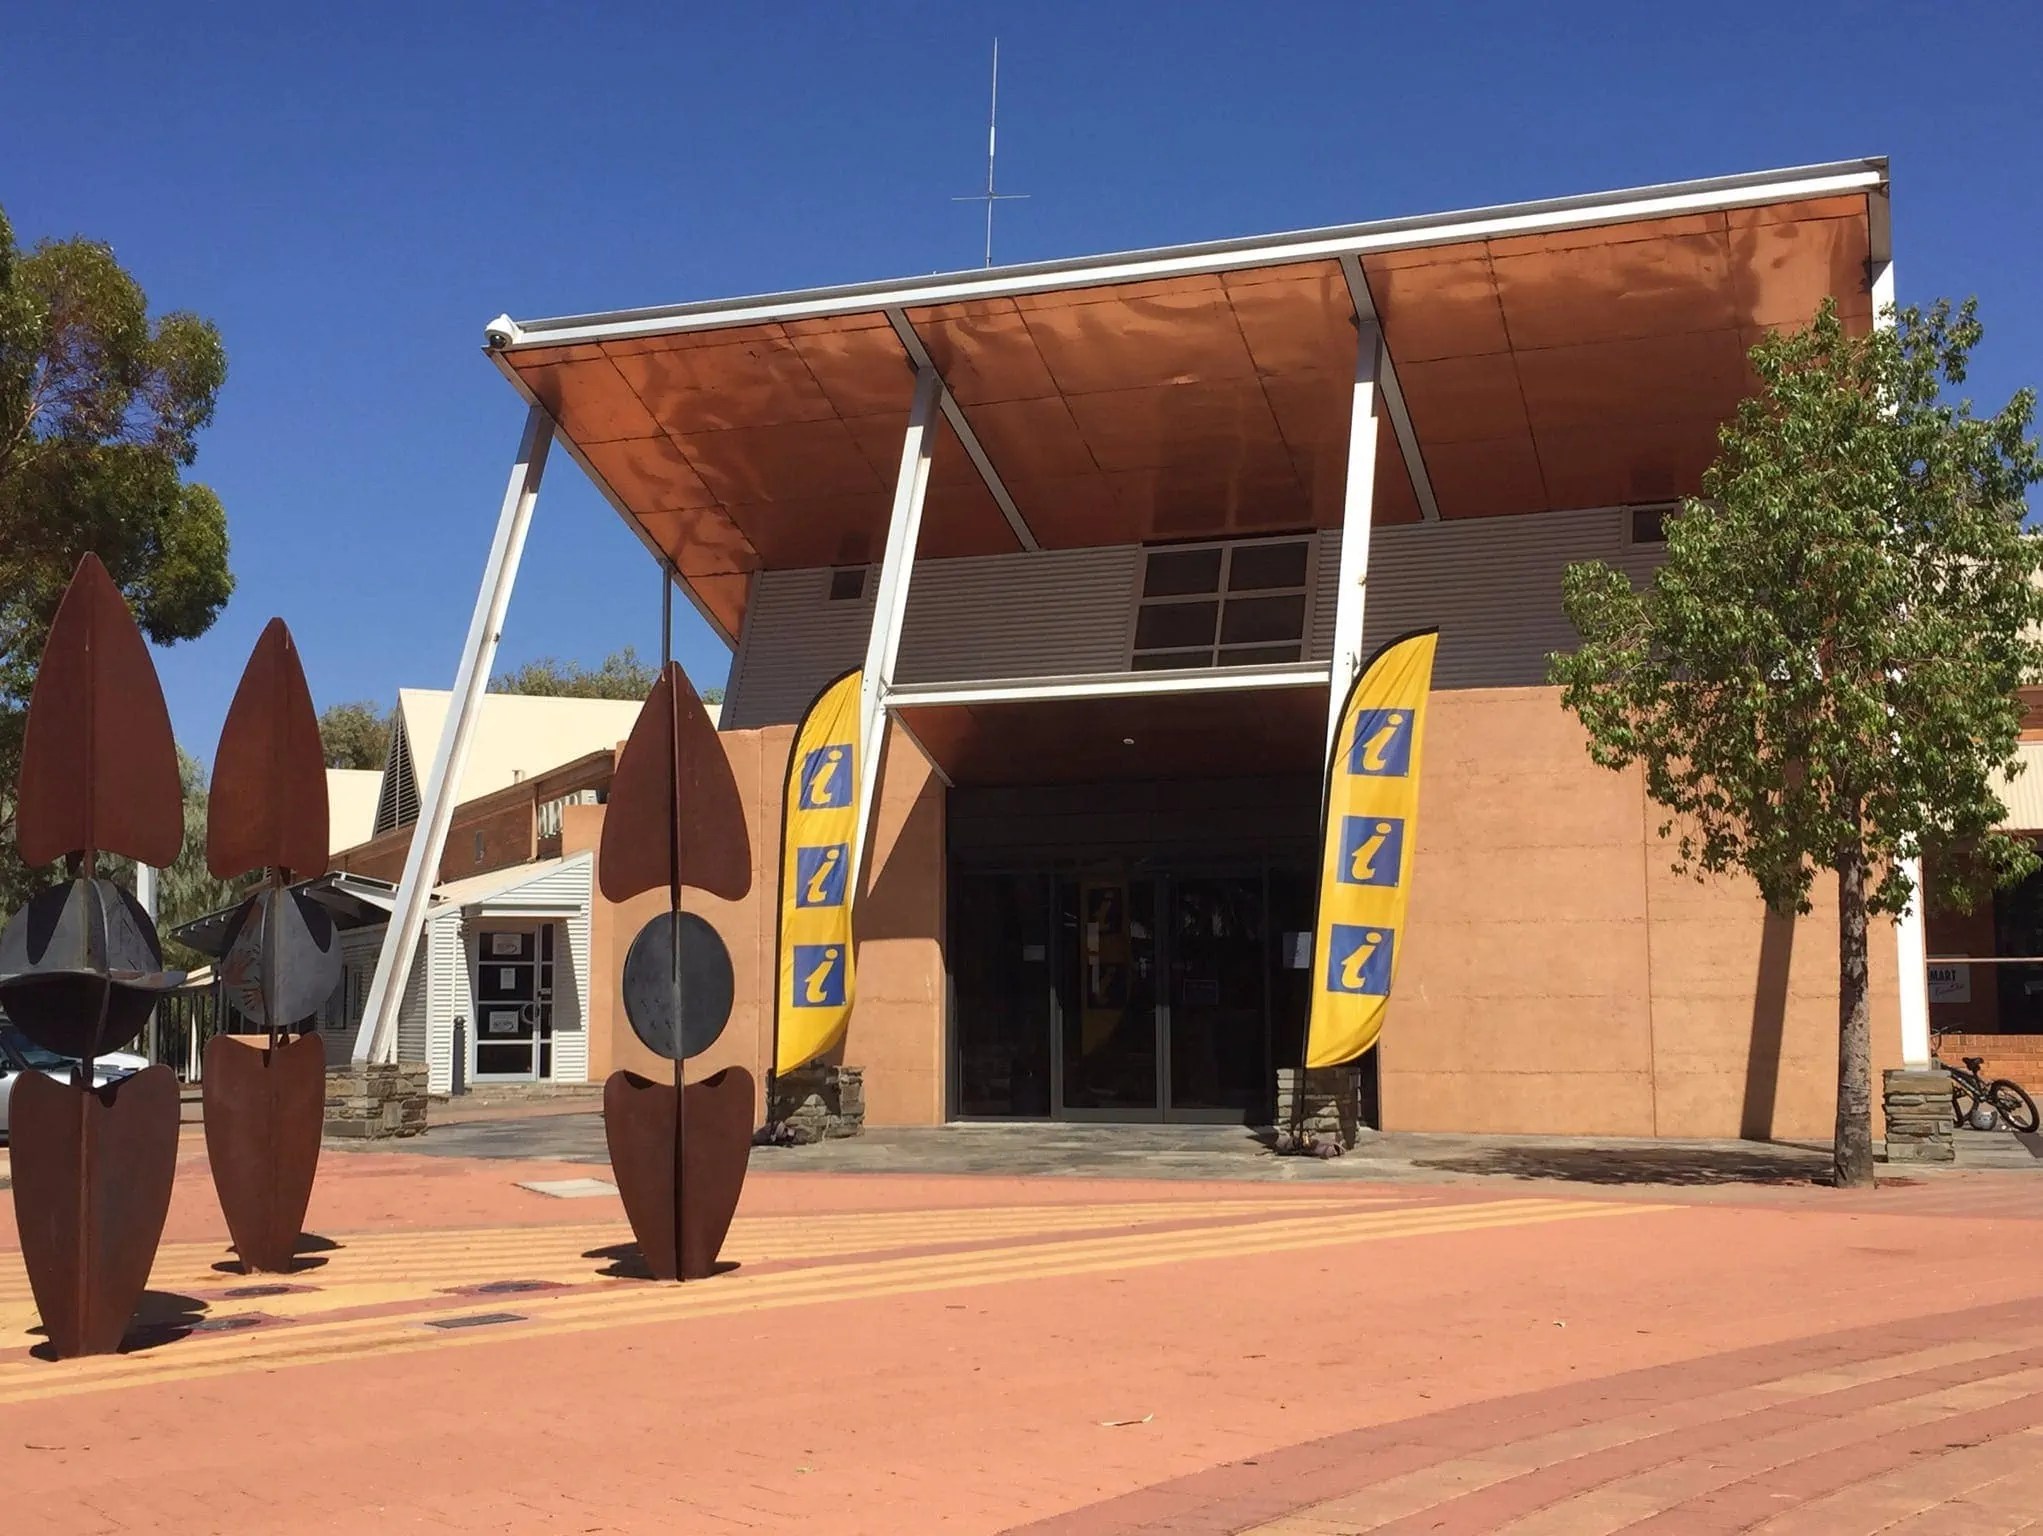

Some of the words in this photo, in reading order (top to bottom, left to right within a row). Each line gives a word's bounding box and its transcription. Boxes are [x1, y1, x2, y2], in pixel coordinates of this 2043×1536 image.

[1362, 713, 1404, 771] i
[809, 749, 843, 805] i
[807, 849, 840, 903] i
[1351, 822, 1392, 880] i
[804, 948, 839, 1003] i
[1341, 931, 1382, 989] i
